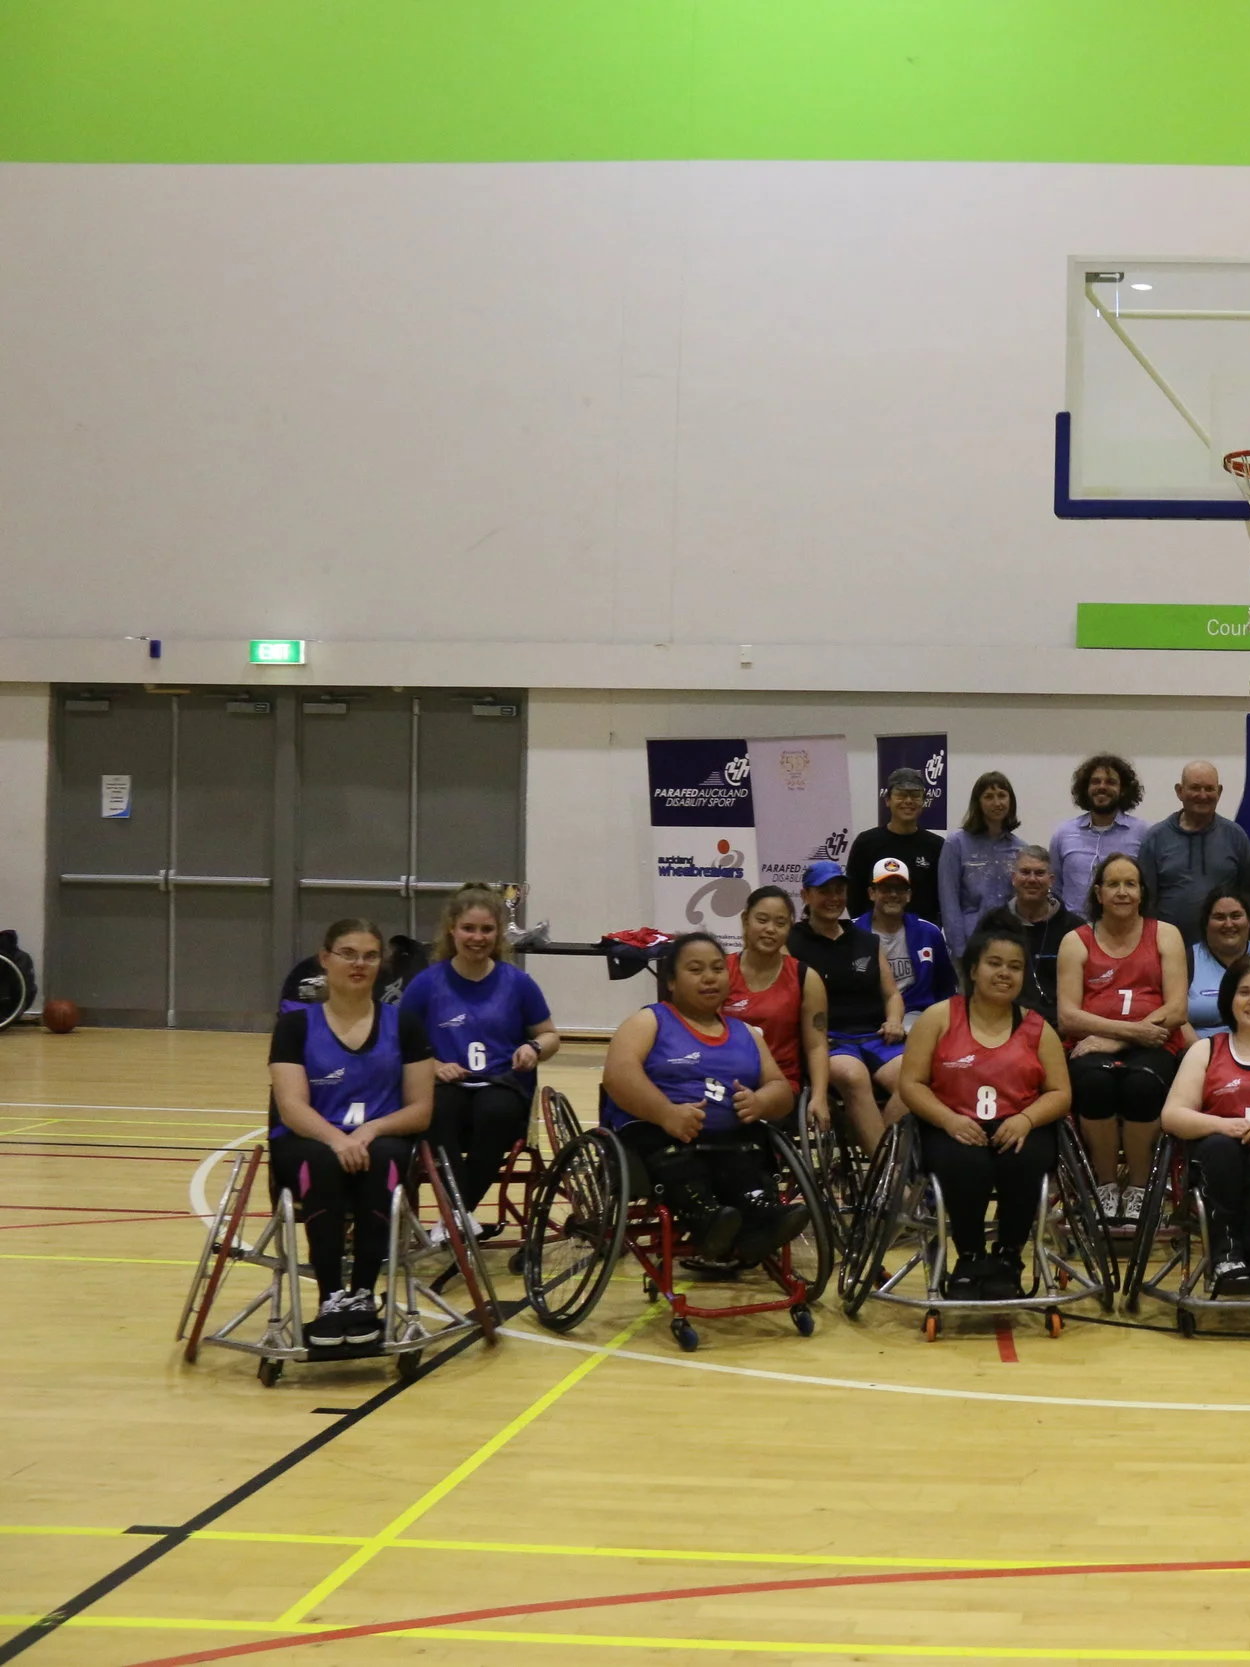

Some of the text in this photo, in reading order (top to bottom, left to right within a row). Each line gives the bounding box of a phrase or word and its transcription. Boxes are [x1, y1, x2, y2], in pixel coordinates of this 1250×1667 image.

[1207, 618, 1250, 636] Cour
[654, 788, 749, 798] PARAFED AUCKLAND
[665, 798, 736, 807] DISABILITY SPORT
[658, 855, 694, 865] auckland
[761, 864, 801, 873] PARAFED
[772, 873, 801, 882] DISABIL
[1118, 989, 1133, 1015] 7
[468, 1041, 487, 1071] 6
[976, 1085, 997, 1120] 8
[342, 1102, 366, 1125] 4
